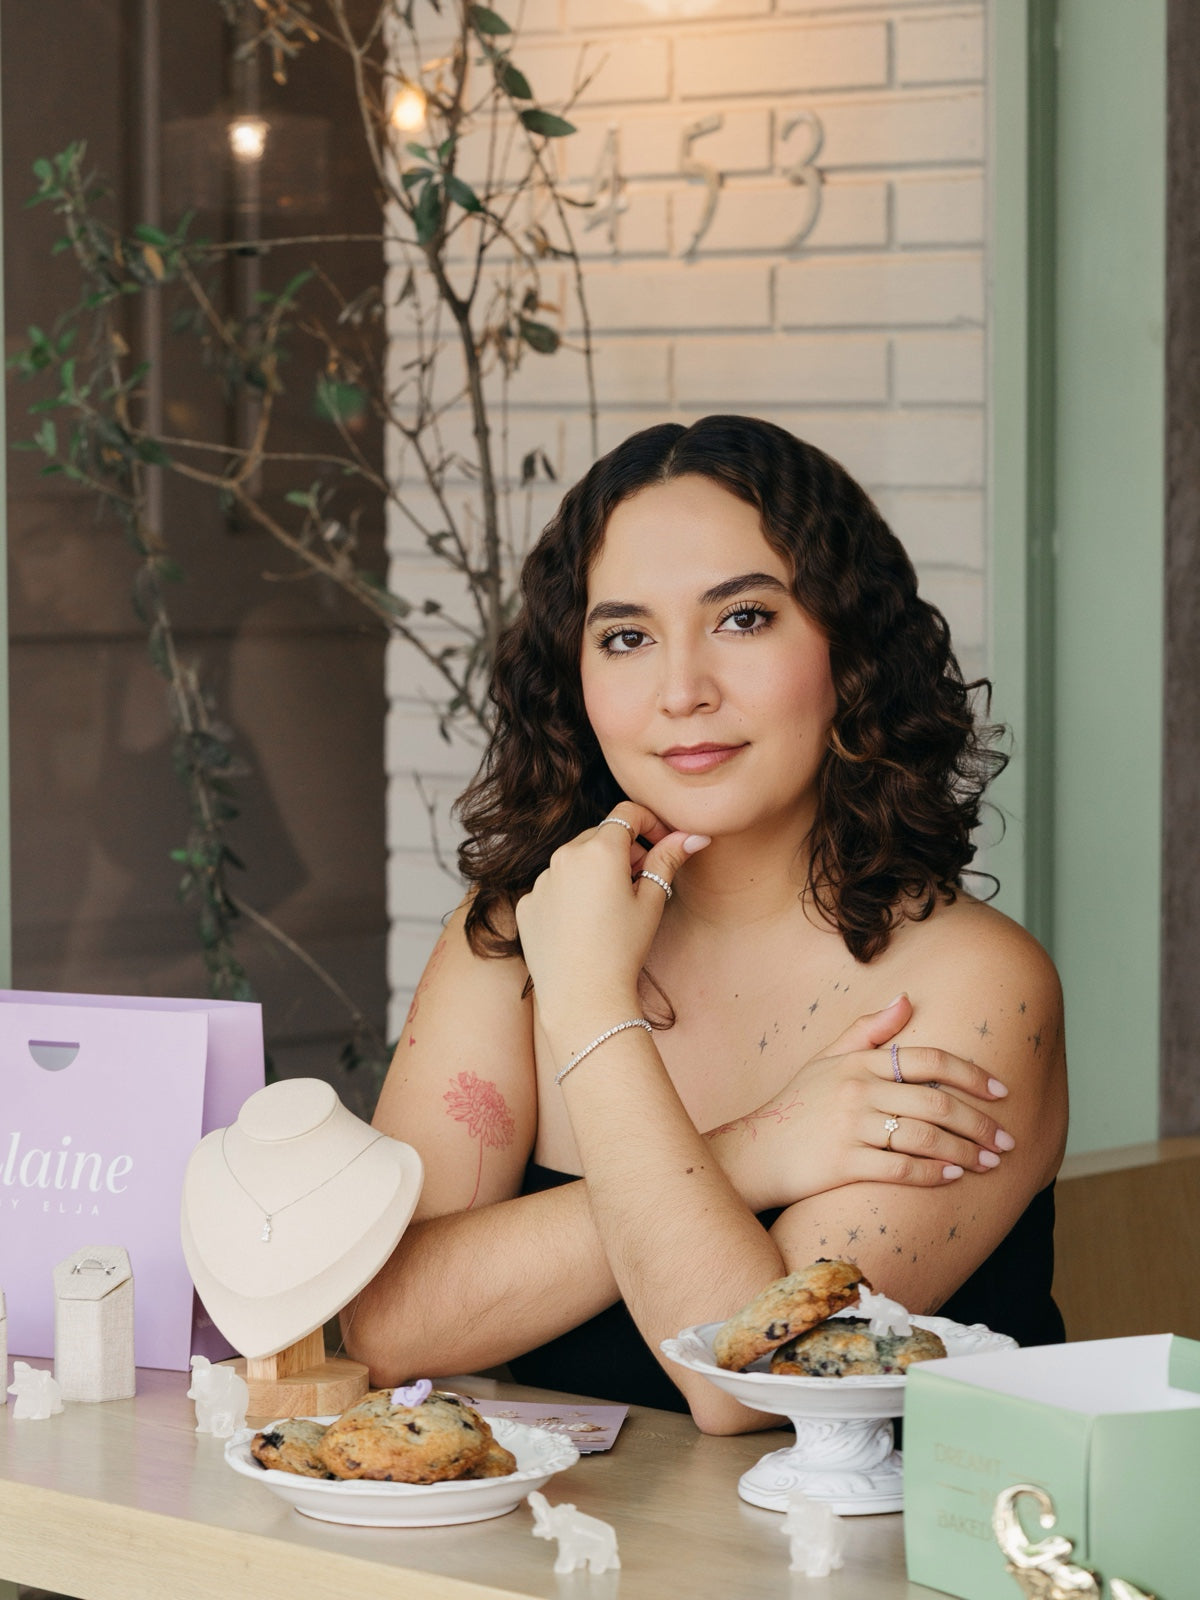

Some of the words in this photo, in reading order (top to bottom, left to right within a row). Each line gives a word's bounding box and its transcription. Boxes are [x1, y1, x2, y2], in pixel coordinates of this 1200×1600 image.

[584, 110, 826, 266] 453
[0, 1131, 134, 1193] laine
[43, 1200, 100, 1216] ELJA
